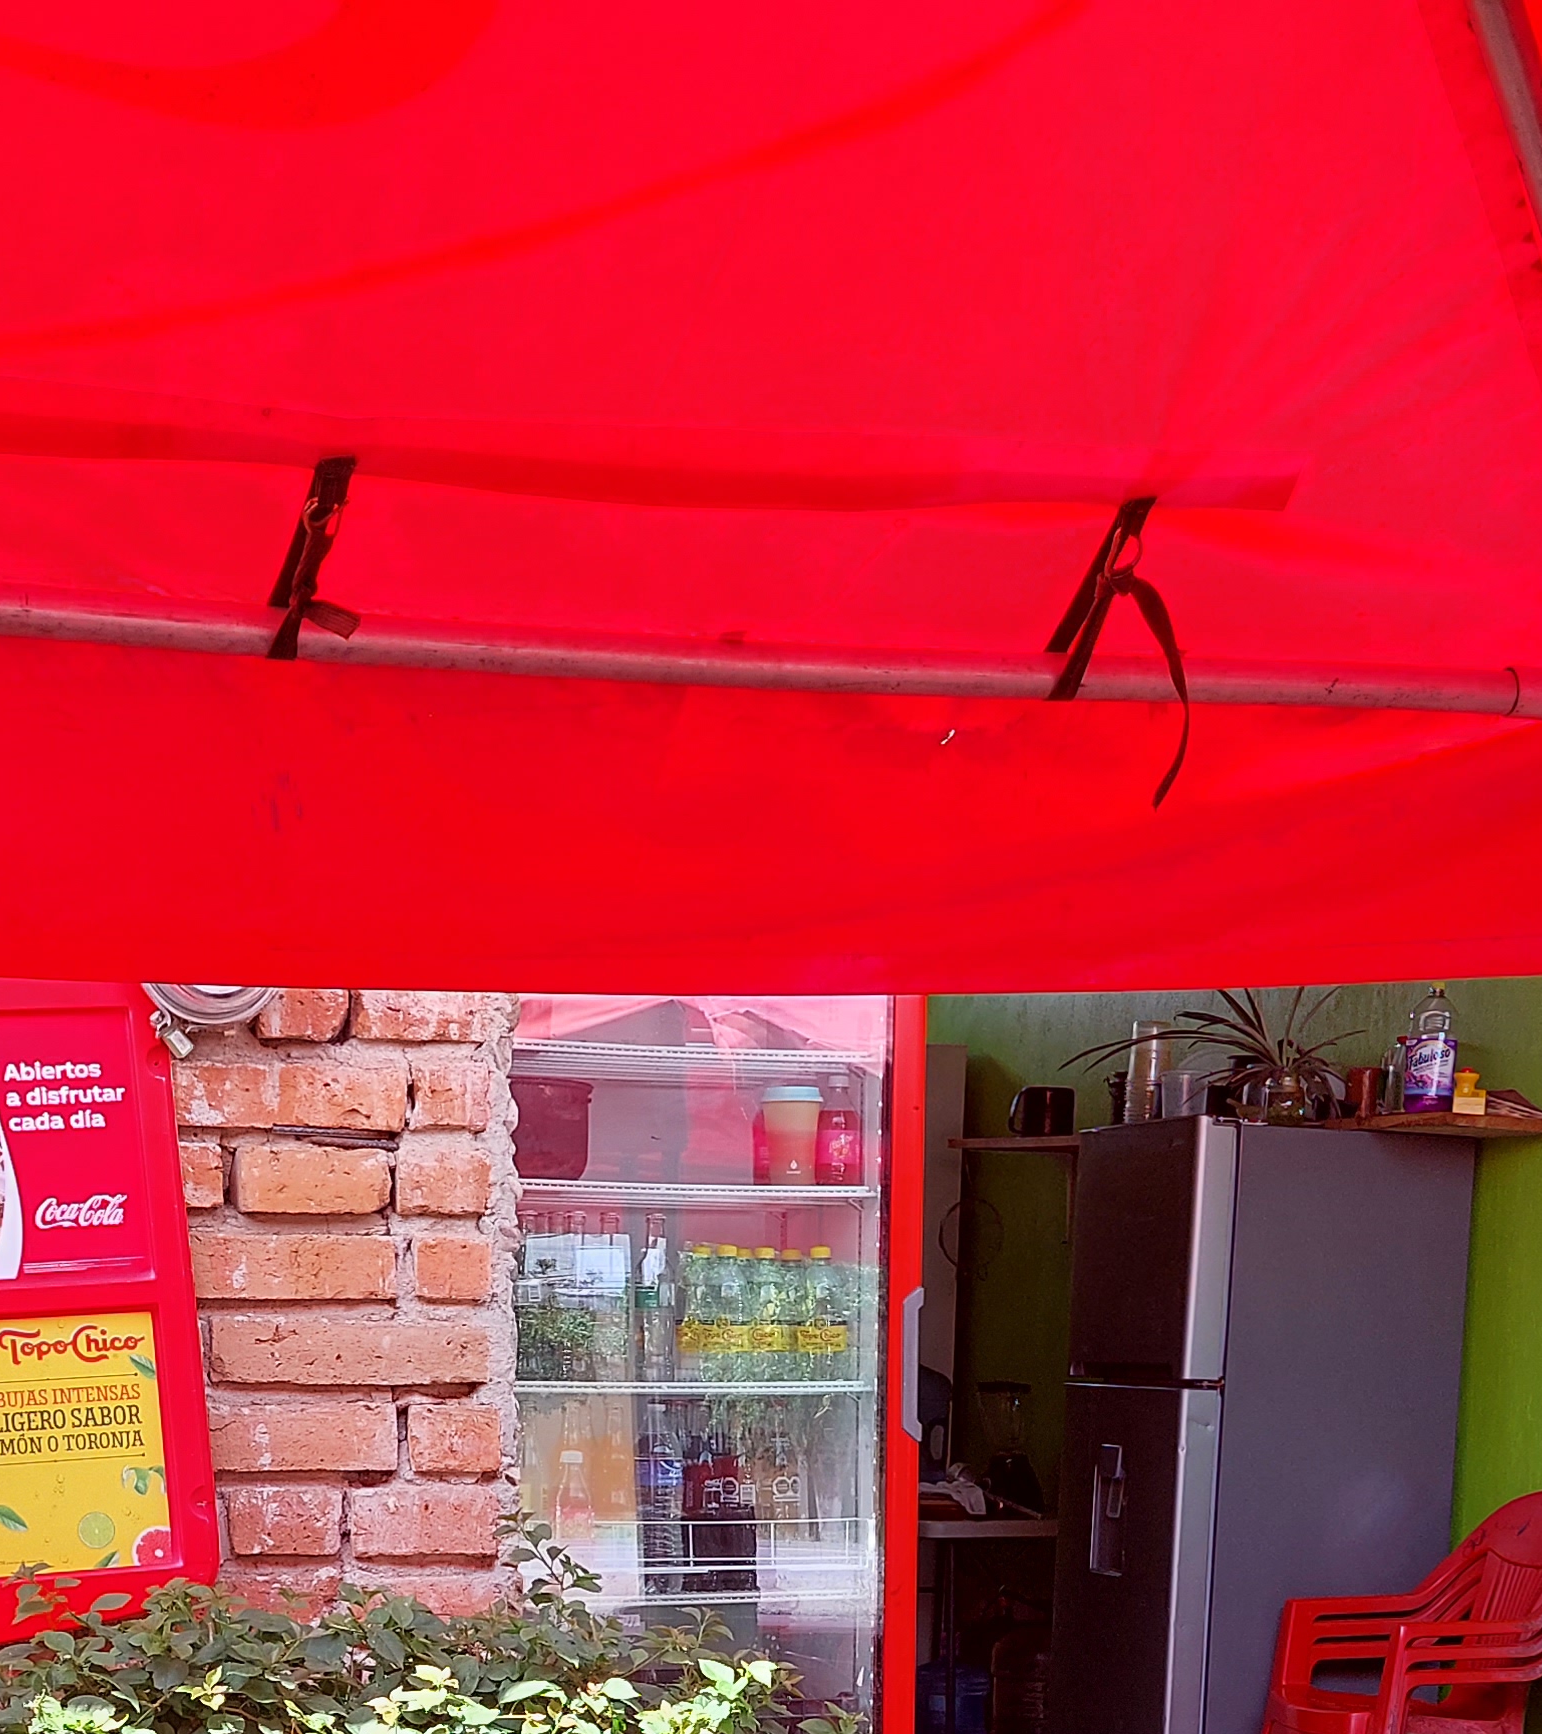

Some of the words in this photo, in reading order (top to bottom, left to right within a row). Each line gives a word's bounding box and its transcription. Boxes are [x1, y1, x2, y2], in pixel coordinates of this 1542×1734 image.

[4, 1061, 102, 1082] Abiertos
[6, 1092, 21, 1107] a
[26, 1086, 125, 1107] disfrutar
[8, 1112, 66, 1132] cada
[69, 1109, 106, 1129] día
[52, 1383, 141, 1405] INTENSAS
[70, 1404, 143, 1429] SABOR
[47, 1435, 59, 1453] O
[62, 1430, 145, 1452] TORONJA
